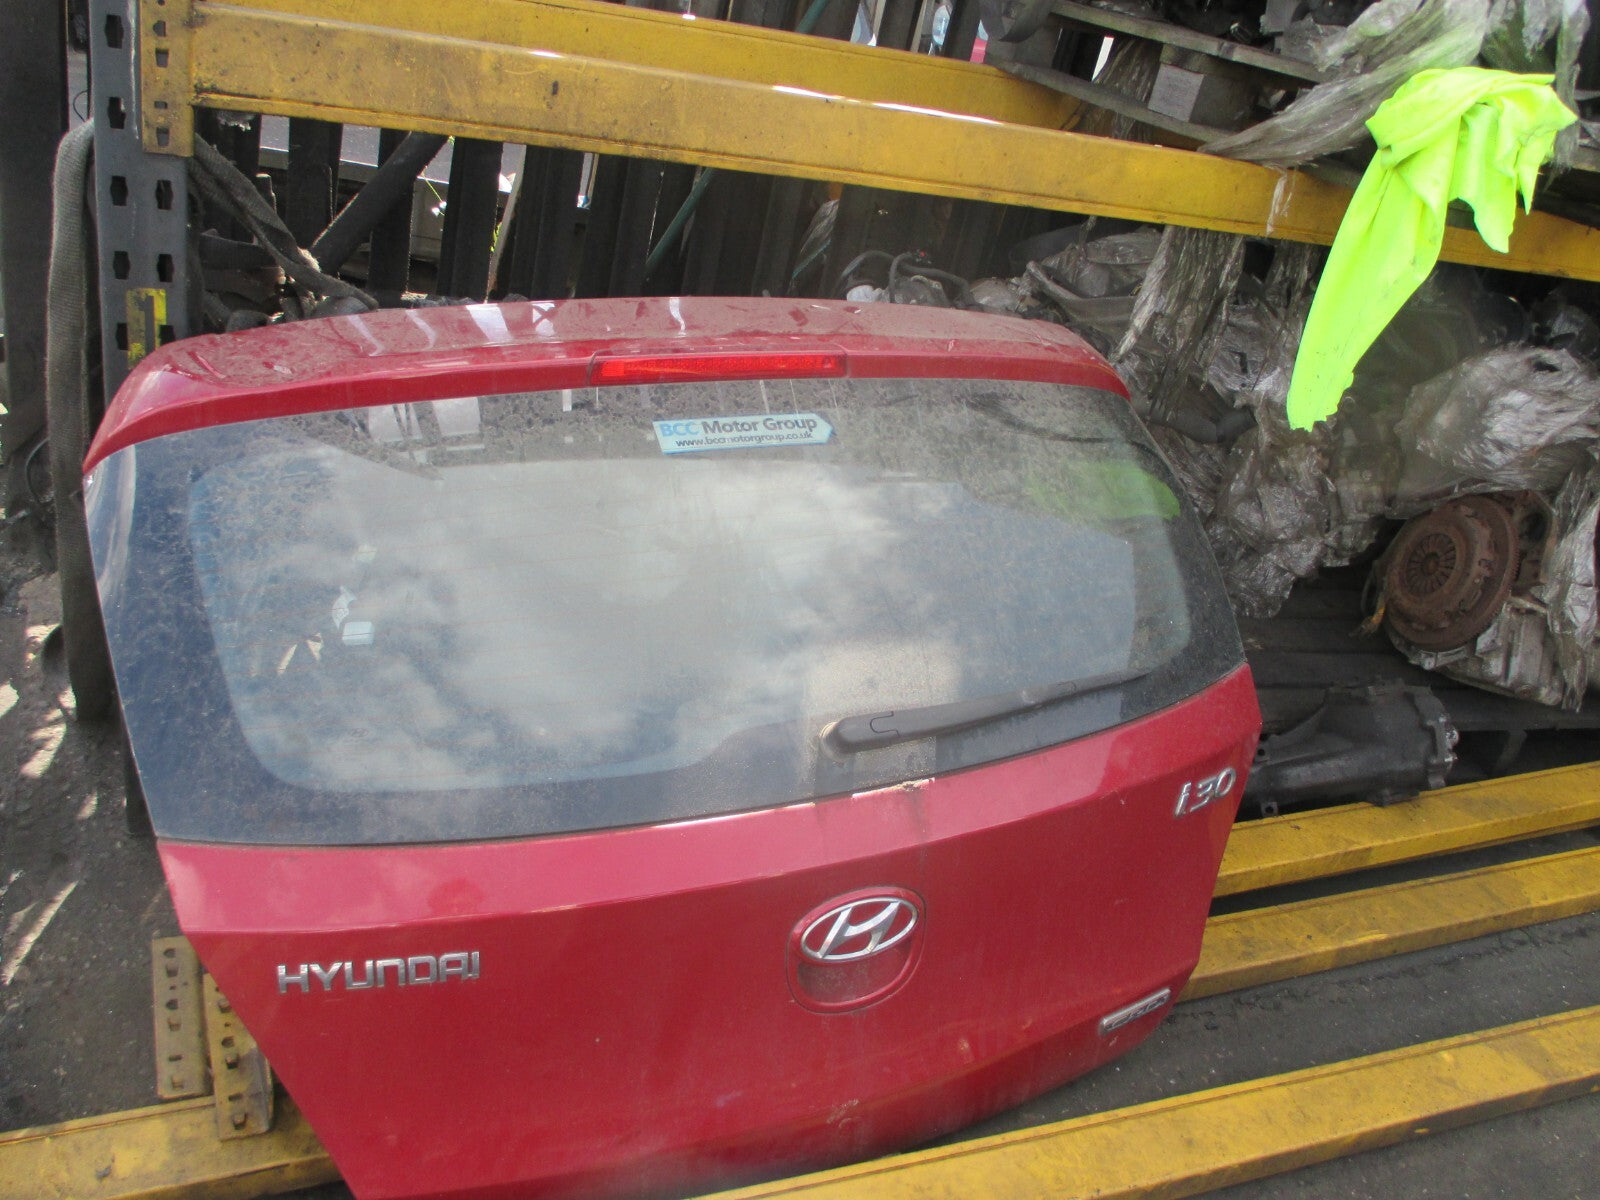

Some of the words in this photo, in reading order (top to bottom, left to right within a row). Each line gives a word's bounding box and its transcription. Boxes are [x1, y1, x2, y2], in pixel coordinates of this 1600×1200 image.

[659, 422, 700, 437] BCC
[701, 420, 759, 434] Motor
[762, 417, 818, 432] Group
[675, 430, 814, 447] www.bccmotorgroup.co.uk
[1174, 767, 1236, 817] i30
[276, 951, 480, 994] HYUNDAI
